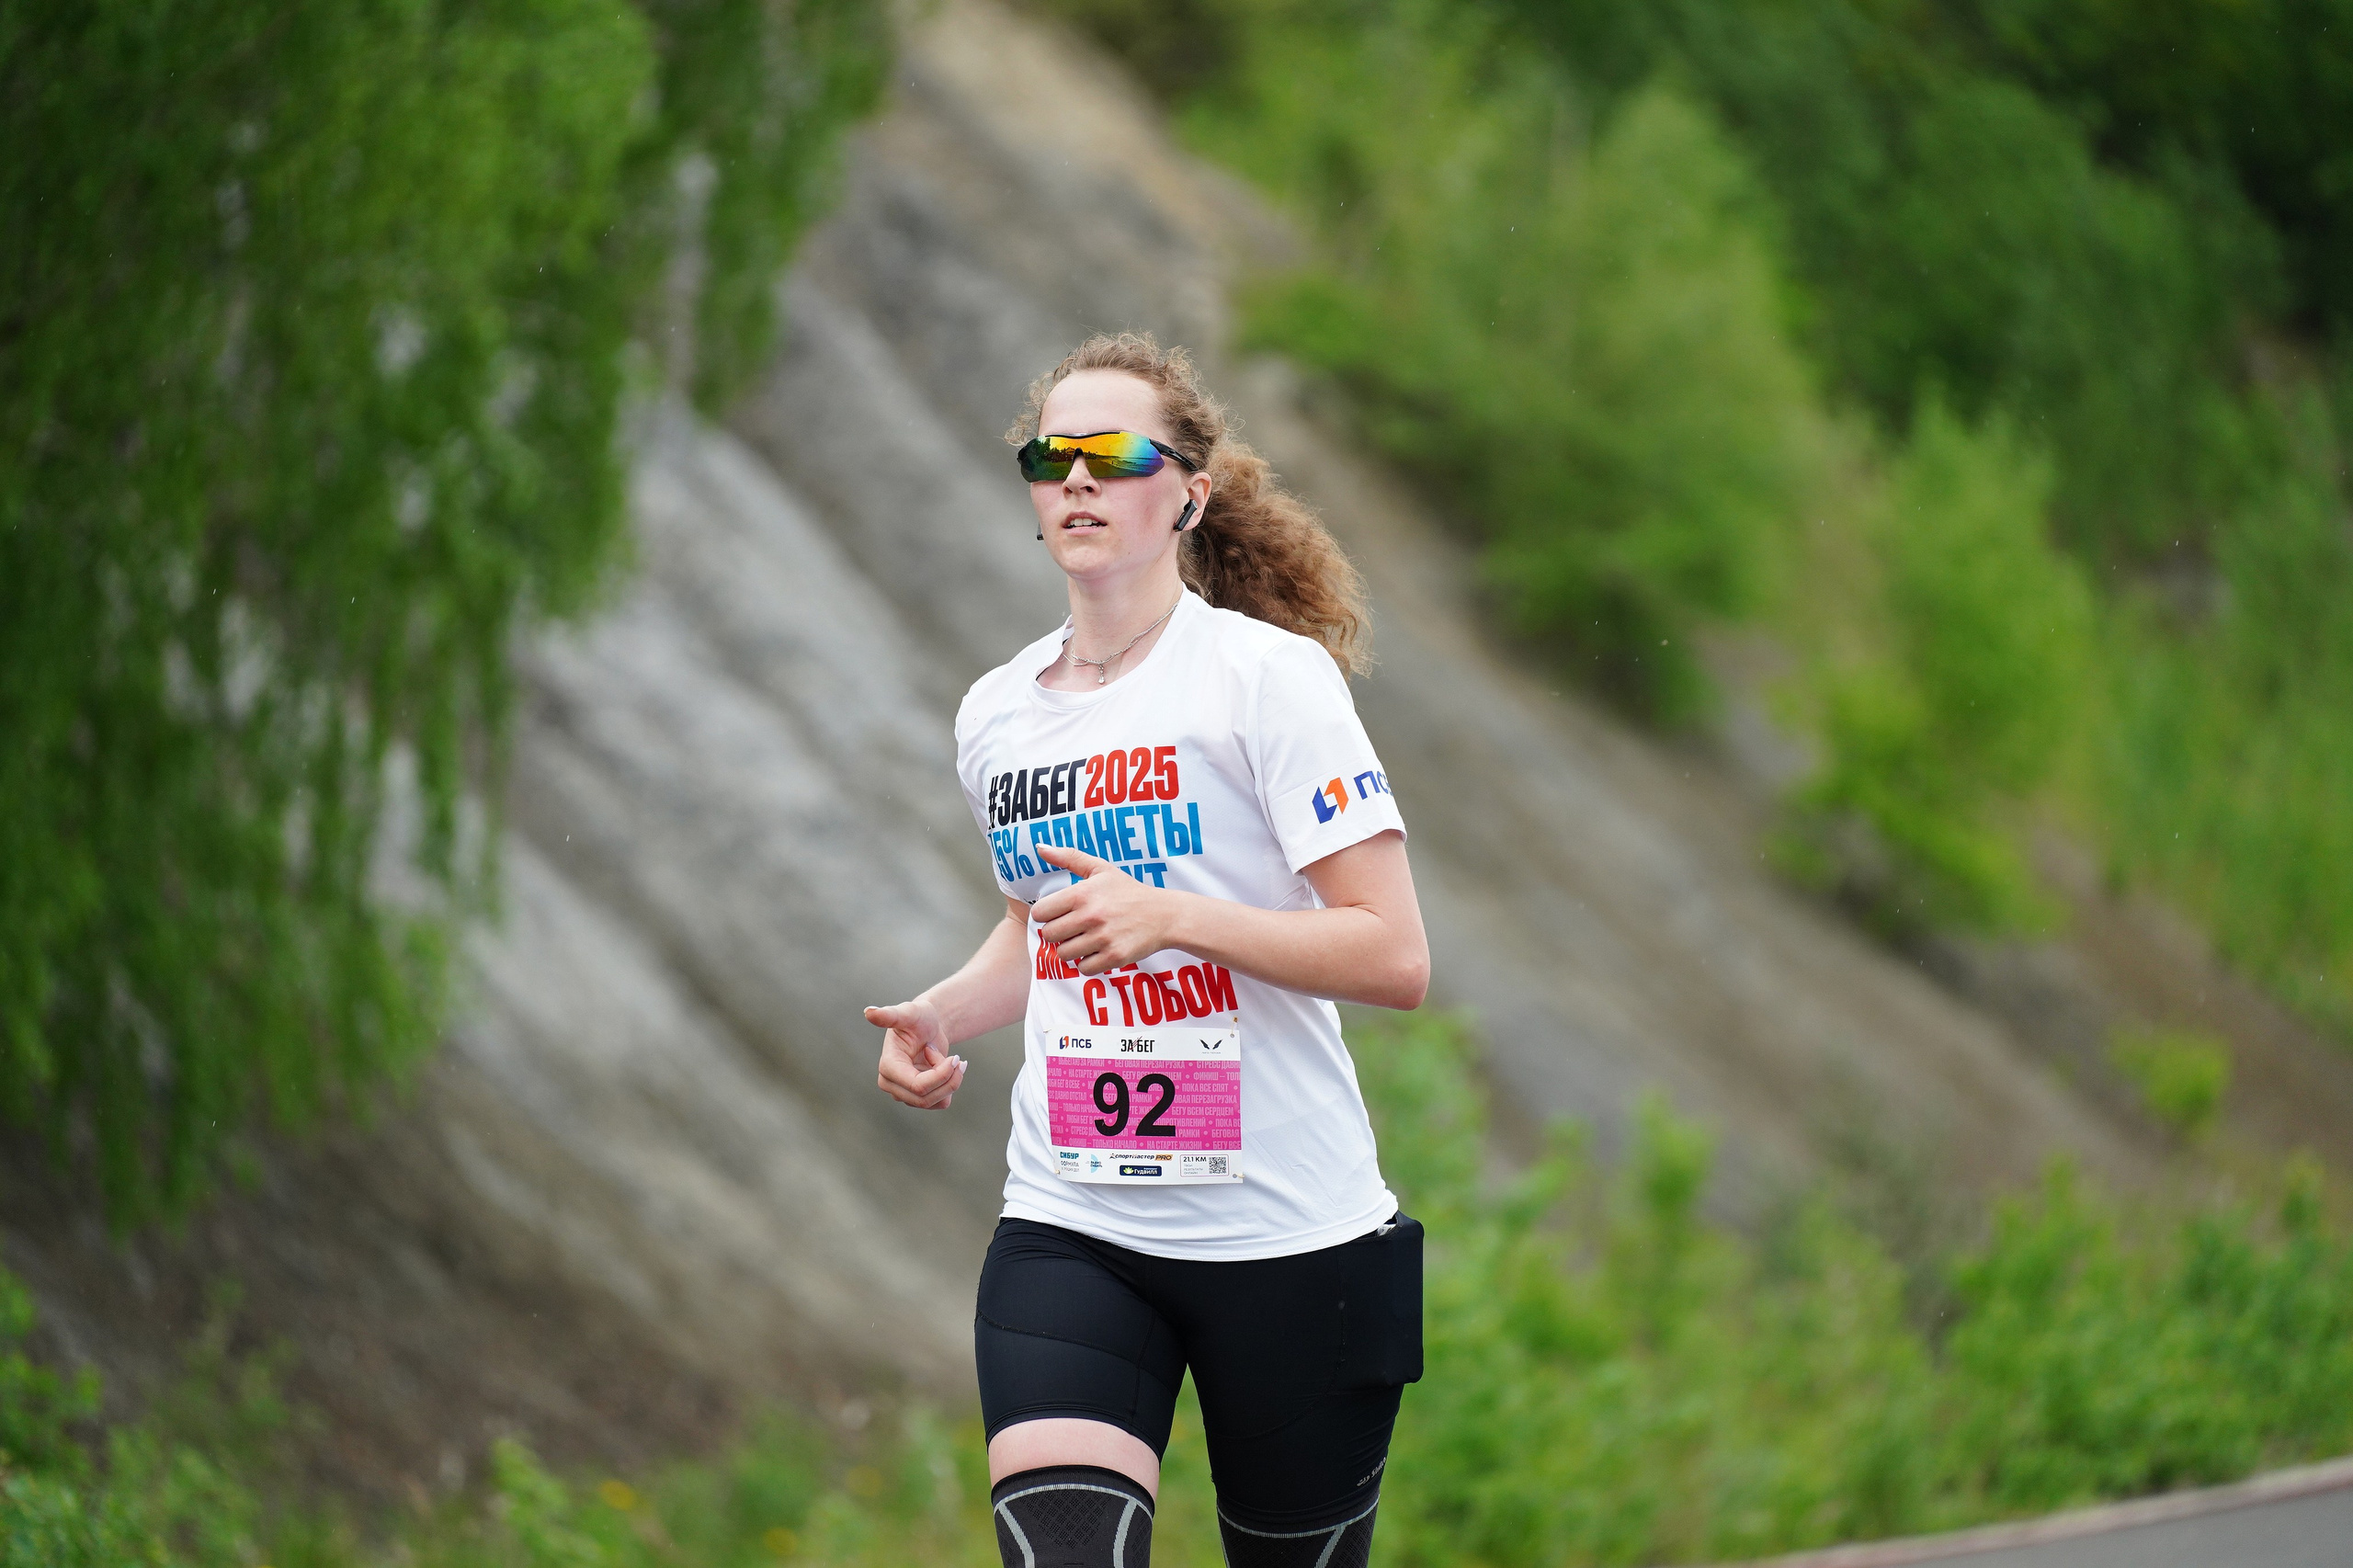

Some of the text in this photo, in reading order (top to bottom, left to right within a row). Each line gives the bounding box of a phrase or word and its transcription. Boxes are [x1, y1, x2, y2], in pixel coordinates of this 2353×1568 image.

[1353, 770, 1394, 800] ПС
[1083, 976, 1109, 1026] С
[1072, 1038, 1092, 1049] ПСБ
[1093, 1072, 1176, 1137] 92
